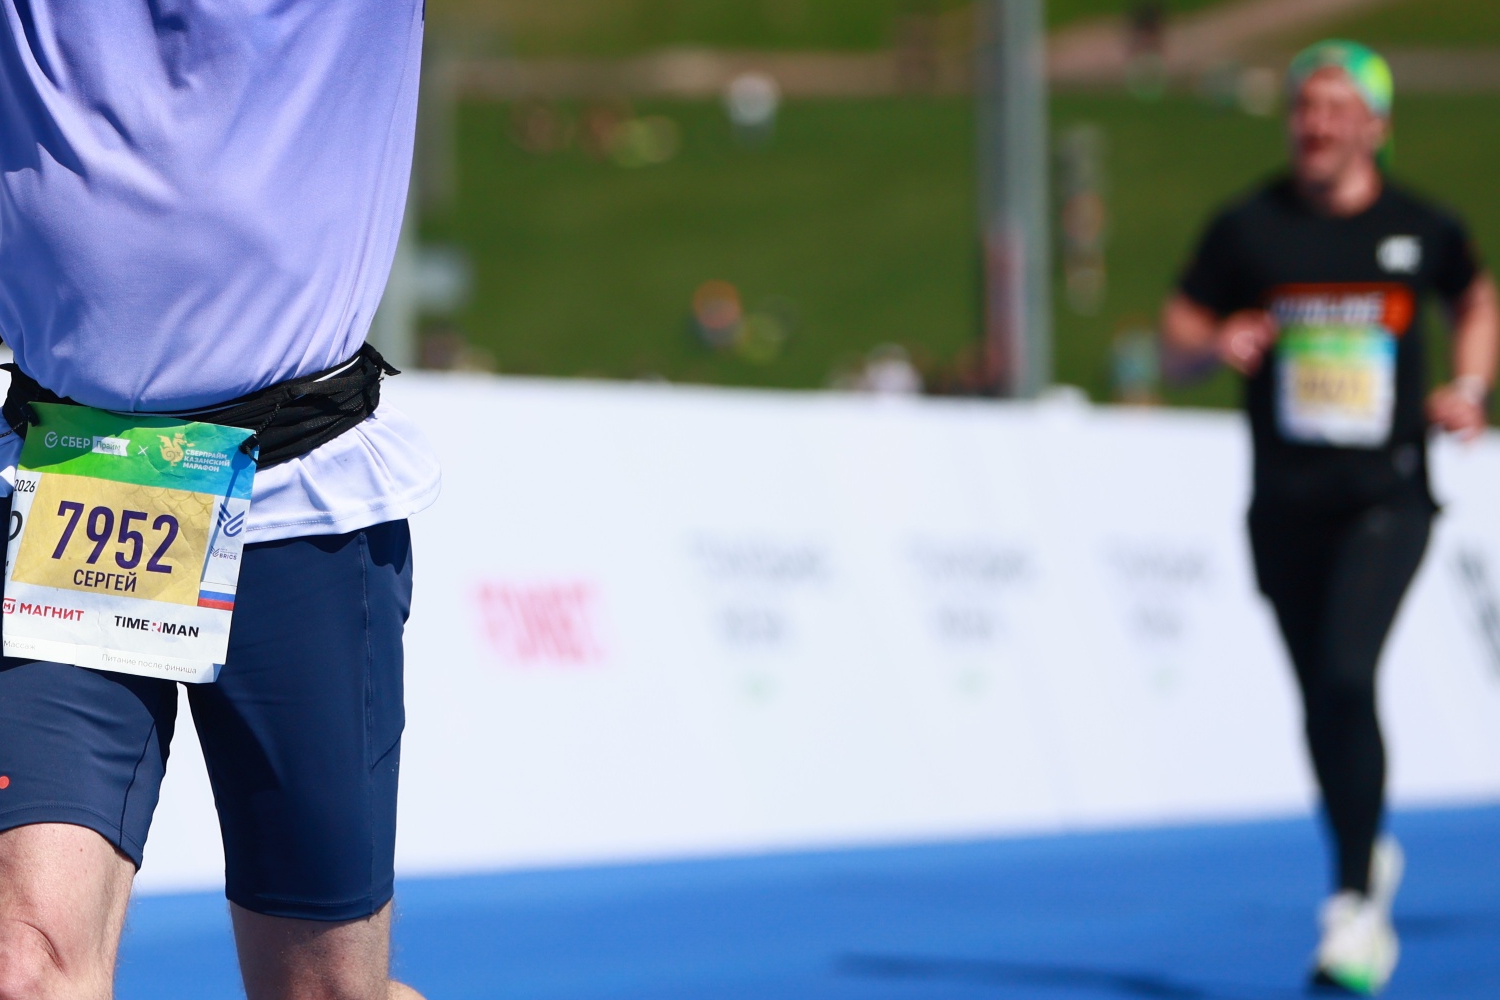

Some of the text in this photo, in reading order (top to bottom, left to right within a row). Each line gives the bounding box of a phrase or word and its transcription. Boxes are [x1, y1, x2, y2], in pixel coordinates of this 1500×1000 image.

[61, 435, 90, 449] СБЕР
[185, 449, 227, 459] СБЕРПРАЙМ
[183, 462, 220, 472] МАРАФОН
[184, 456, 231, 467] КАЗАНСКИЙ
[51, 500, 179, 574] 7952
[219, 552, 237, 561] BRICS
[73, 569, 137, 593] СЕРГЕЙ
[19, 602, 85, 621] МАГНИТ
[3, 640, 36, 650] Массаж
[101, 653, 197, 674] Питание после финиша
